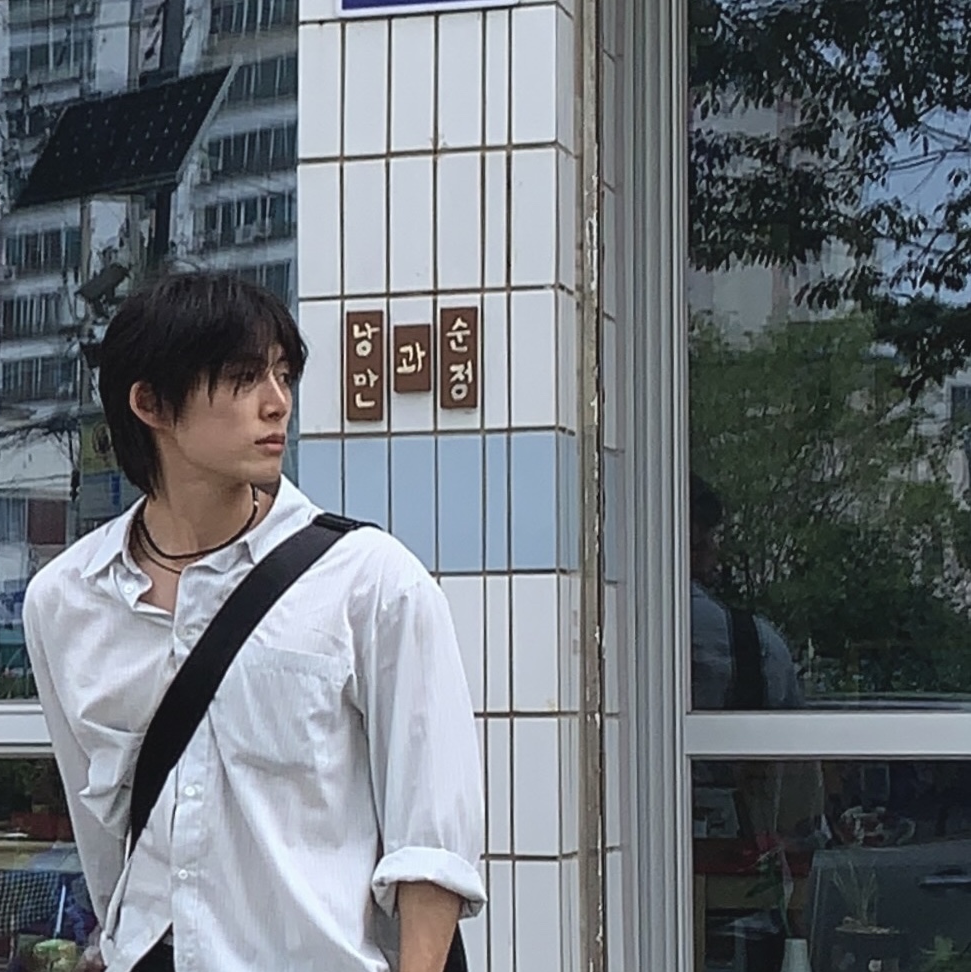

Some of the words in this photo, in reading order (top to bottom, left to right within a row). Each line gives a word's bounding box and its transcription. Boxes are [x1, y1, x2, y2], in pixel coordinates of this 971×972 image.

[352, 322, 380, 409] 낭만
[396, 342, 426, 374] 과
[445, 317, 474, 401] 순정
